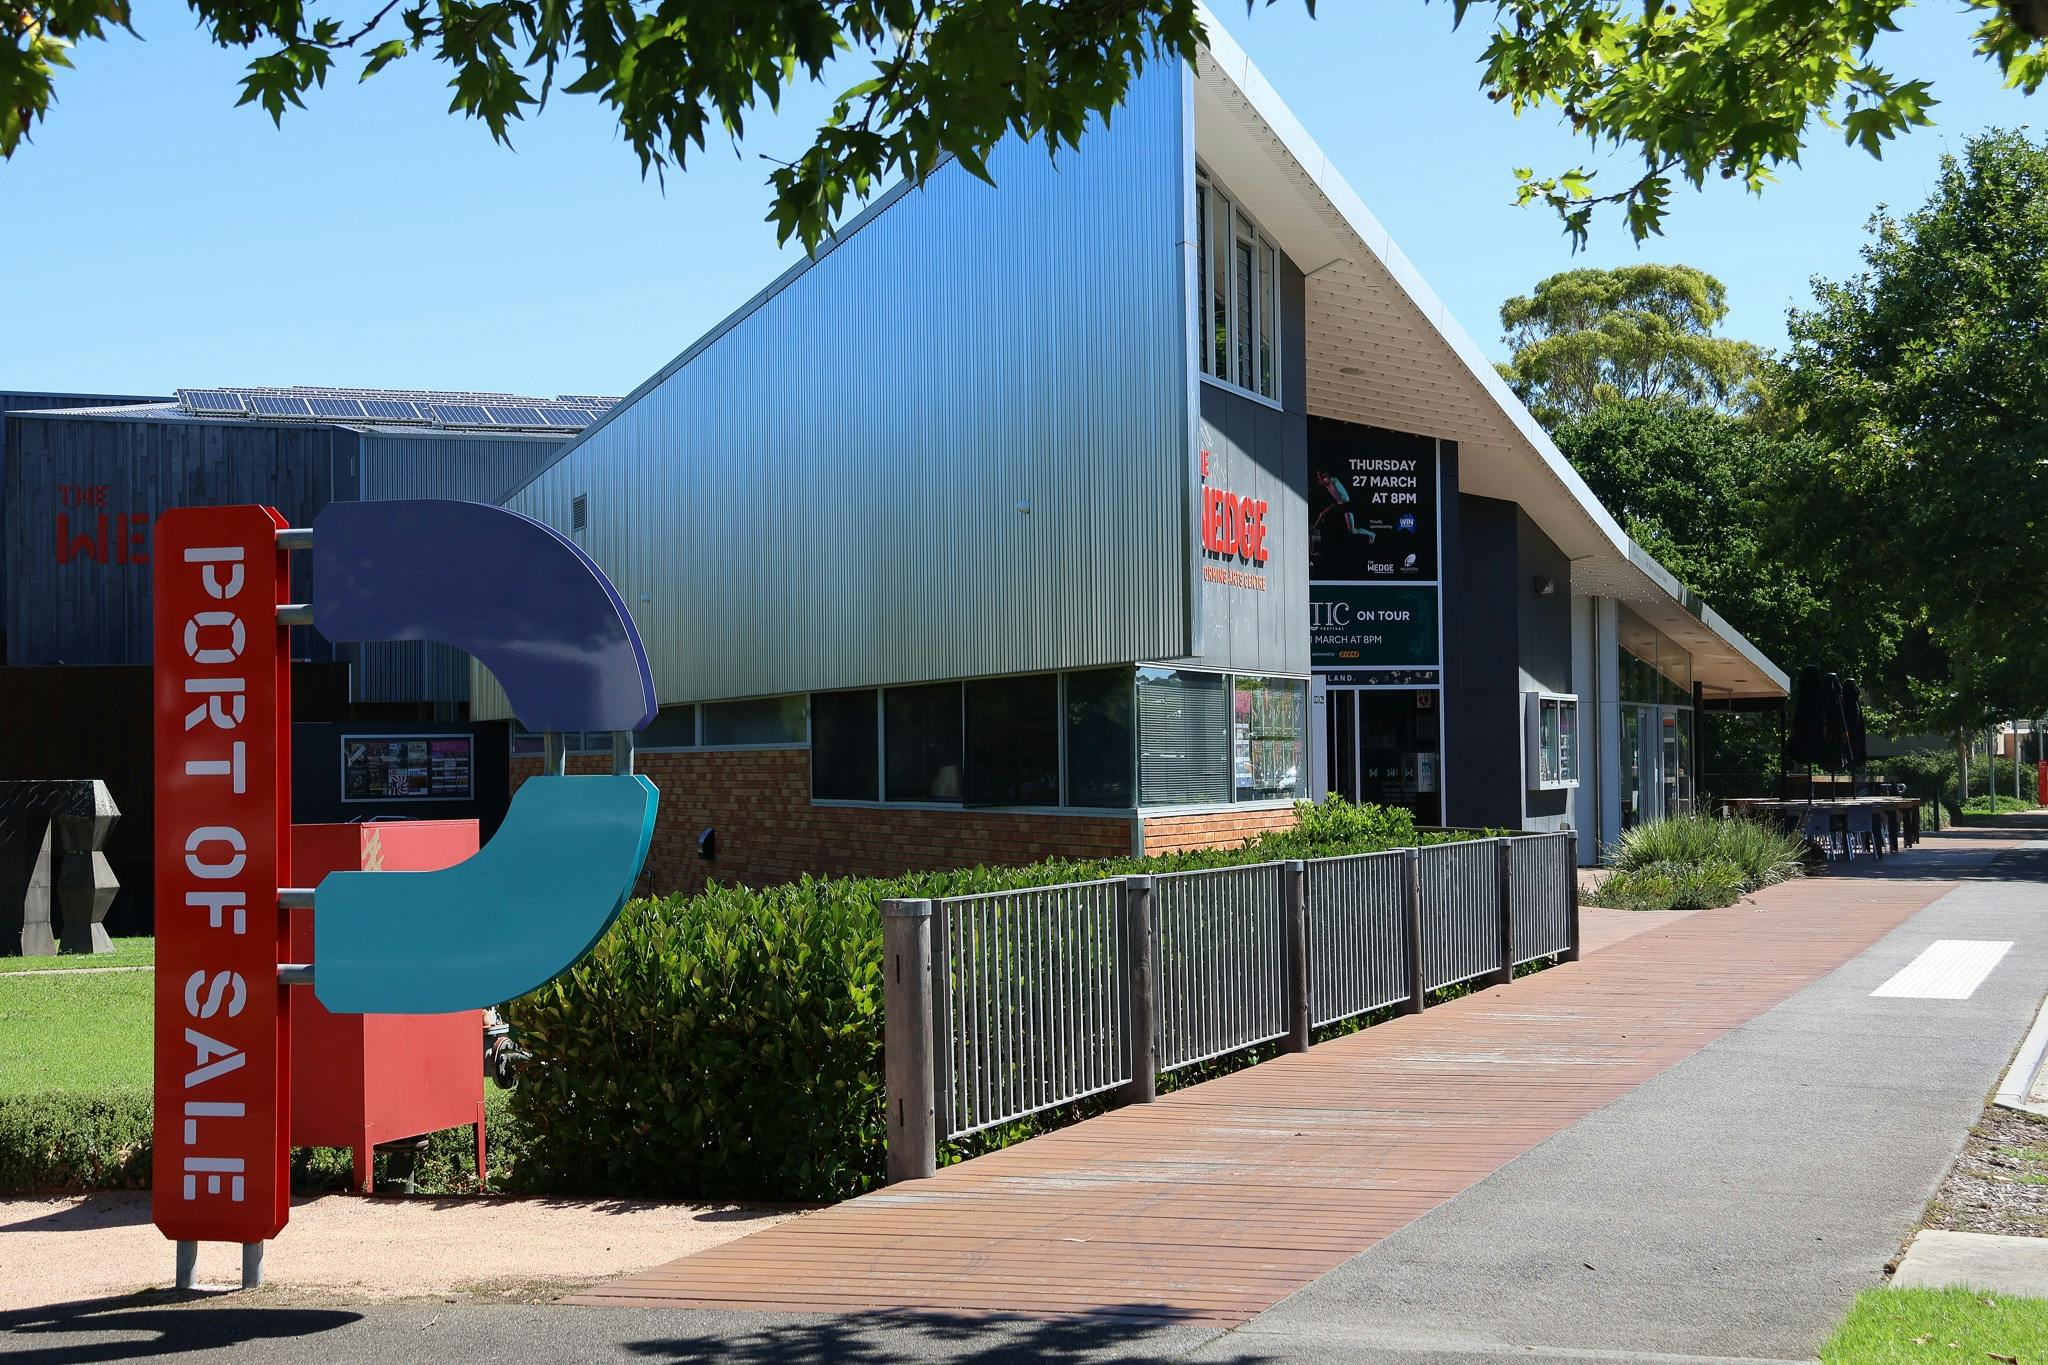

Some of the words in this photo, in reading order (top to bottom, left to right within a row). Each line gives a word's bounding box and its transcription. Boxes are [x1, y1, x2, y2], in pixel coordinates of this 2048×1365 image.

[1348, 458, 1417, 471] THURSDAY
[1352, 475, 1368, 488] 27
[1370, 476, 1417, 488] MARCH
[56, 484, 112, 508] THE
[1371, 492, 1388, 504] AT
[1390, 492, 1417, 504] 8PM
[1400, 518, 1414, 526] WIN
[1203, 565, 1227, 584] ORMING
[1229, 569, 1242, 588] ARTS
[1309, 602, 1350, 626] TIC
[1356, 610, 1375, 621] ON
[1377, 610, 1410, 621] TOUR
[1315, 635, 1348, 644] MARCH
[1350, 635, 1361, 644] AT
[1363, 635, 1382, 644] 8PM
[183, 546, 246, 794] PORT
[184, 826, 247, 935] OF
[183, 970, 247, 1202] SALE
